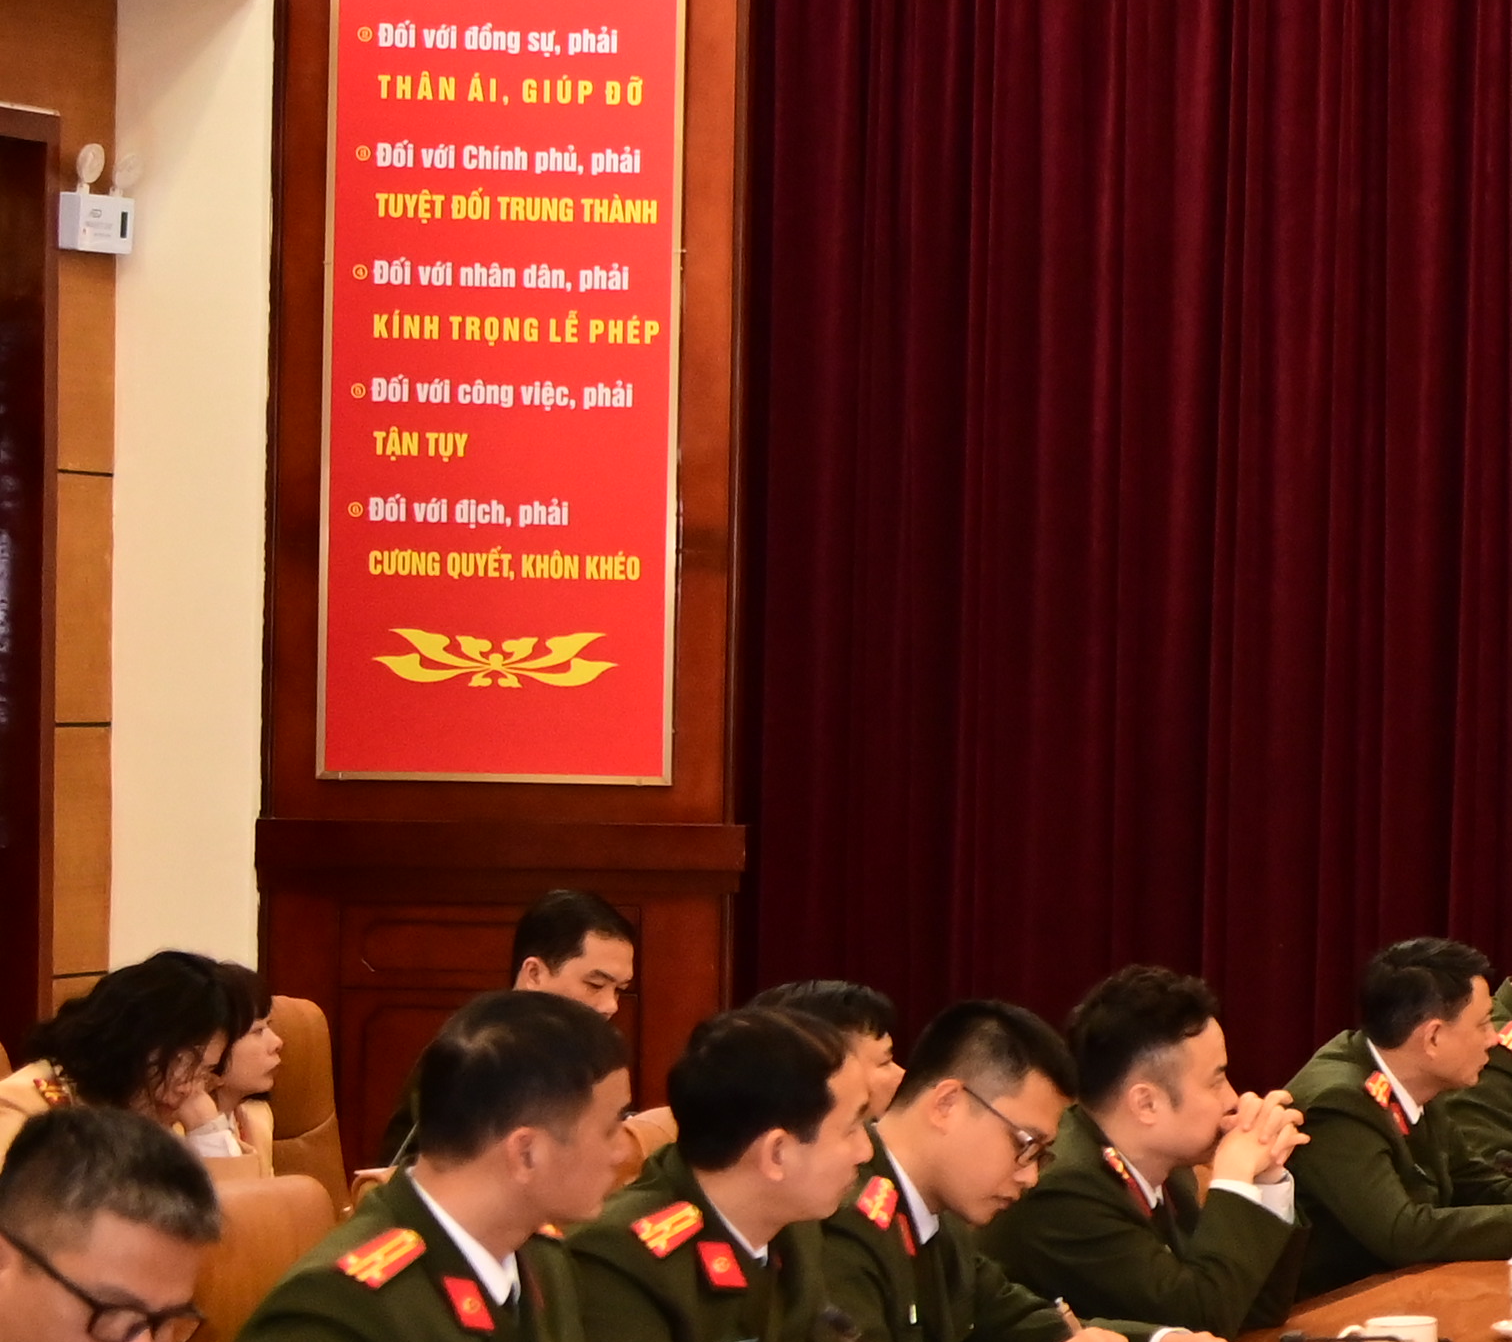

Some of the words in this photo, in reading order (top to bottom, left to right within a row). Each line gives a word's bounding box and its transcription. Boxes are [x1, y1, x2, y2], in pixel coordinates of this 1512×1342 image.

[377, 19, 416, 49] Đối
[422, 23, 458, 50] với
[464, 22, 521, 55] đồng
[527, 29, 561, 58] sự,
[567, 25, 618, 56] phải
[377, 70, 456, 102] THÂN
[467, 72, 509, 106] ÁI,
[522, 74, 594, 105] GIÚP
[604, 75, 644, 106] ĐỠ
[375, 139, 415, 168] Đối
[420, 143, 456, 169] với
[462, 144, 529, 171] Chính
[534, 144, 584, 176] phủ,
[591, 145, 641, 176] phải
[375, 188, 446, 224] TUYỆT
[450, 186, 491, 221] ĐỐI
[496, 196, 574, 223] TRUNG
[580, 193, 658, 224] THÀNH
[372, 256, 412, 286] Đối
[417, 260, 453, 287] với
[459, 262, 516, 288] nhân
[522, 263, 573, 292] dân,
[579, 262, 630, 293] phải
[373, 309, 440, 340] KÍNH
[448, 315, 539, 347] TRỌNG
[549, 309, 579, 343] LỄ
[589, 314, 660, 345] PHÉP
[370, 373, 410, 403] Đối
[415, 378, 451, 404] với
[457, 378, 514, 408] công
[520, 380, 576, 412] việc,
[583, 379, 634, 410] phải
[372, 426, 419, 461] TẬN
[425, 431, 469, 463] TỤY
[368, 493, 407, 522] Đối
[413, 497, 448, 523] với
[454, 498, 512, 529] địch,
[518, 497, 569, 528] phải
[368, 548, 441, 577] CƯƠNG
[446, 545, 515, 581] QUYẾT,
[521, 549, 580, 580] KHÔN
[585, 550, 641, 581] KHÉO
